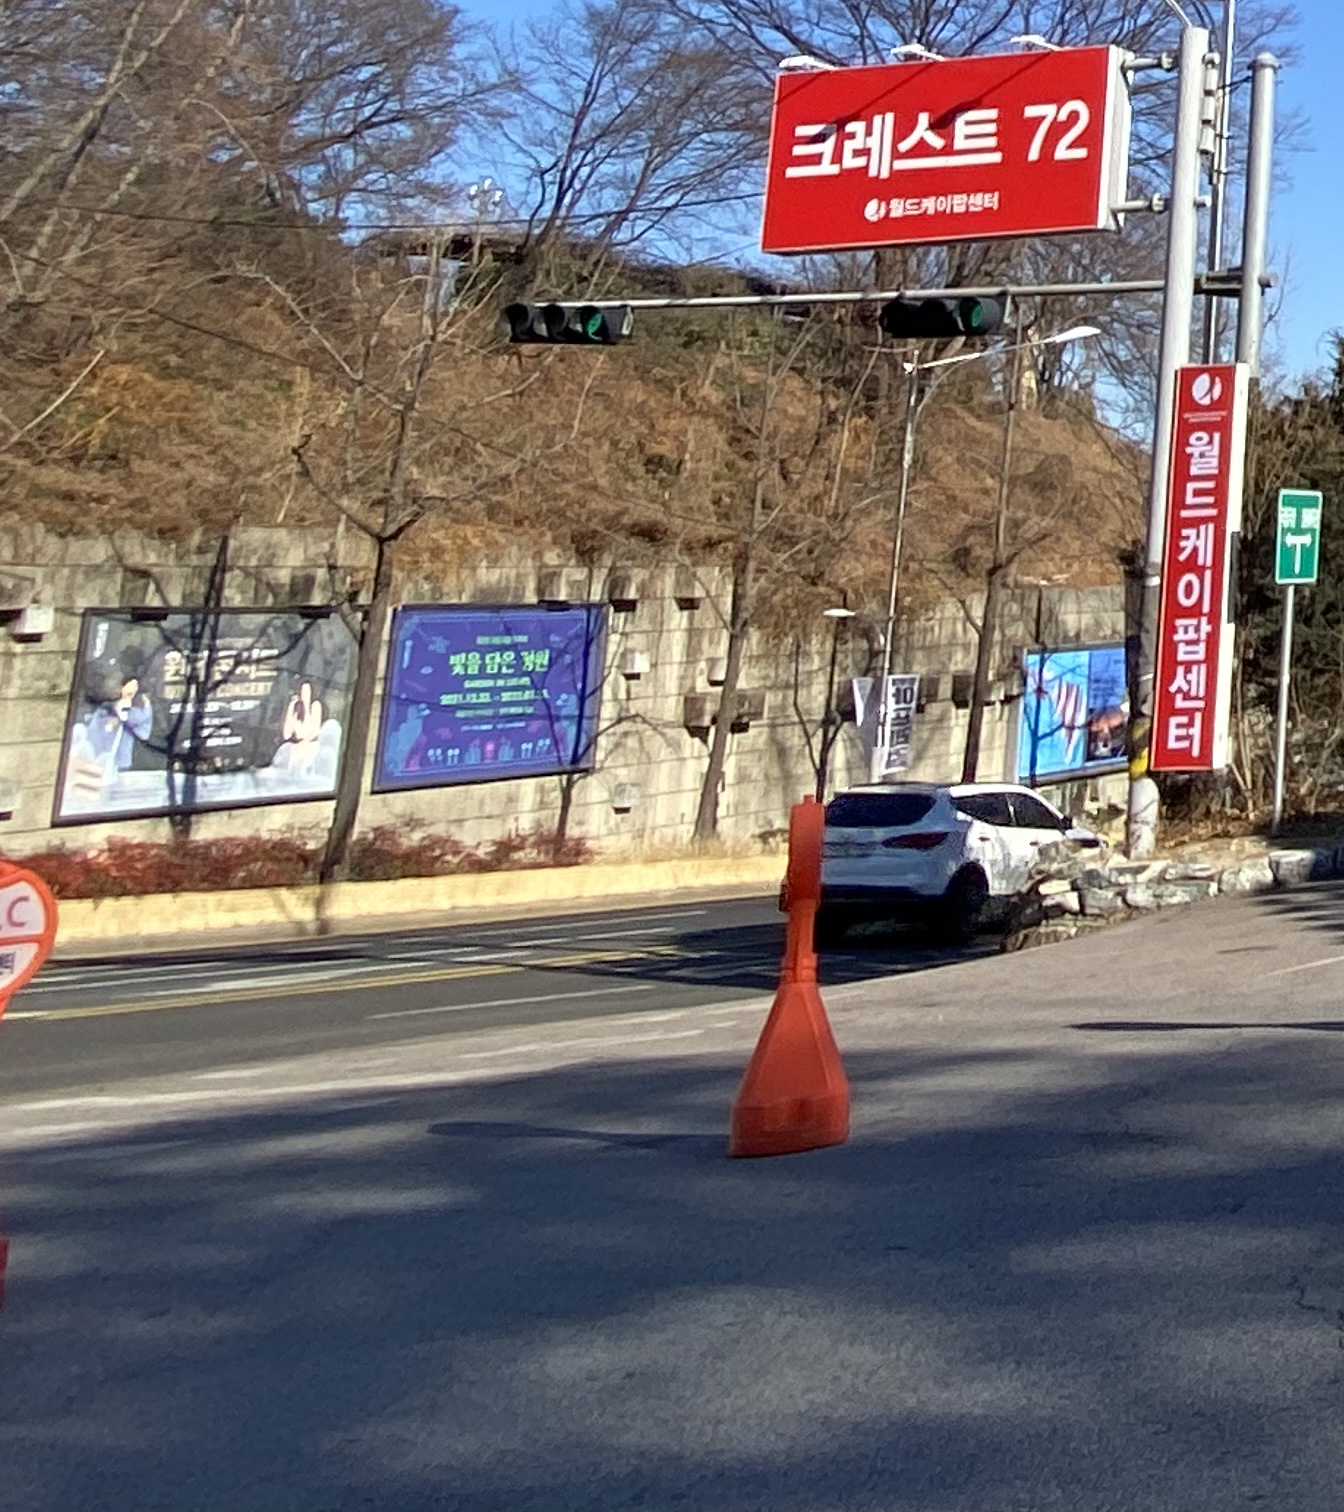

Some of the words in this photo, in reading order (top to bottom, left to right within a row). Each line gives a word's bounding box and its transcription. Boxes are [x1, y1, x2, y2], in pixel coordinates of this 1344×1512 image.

[784, 108, 1003, 179] 크레스트
[1023, 100, 1091, 162] 72
[887, 191, 1000, 219] 월드케이팝센터
[1166, 431, 1221, 758] 월드케이팝센터
[0, 896, 30, 930] C
